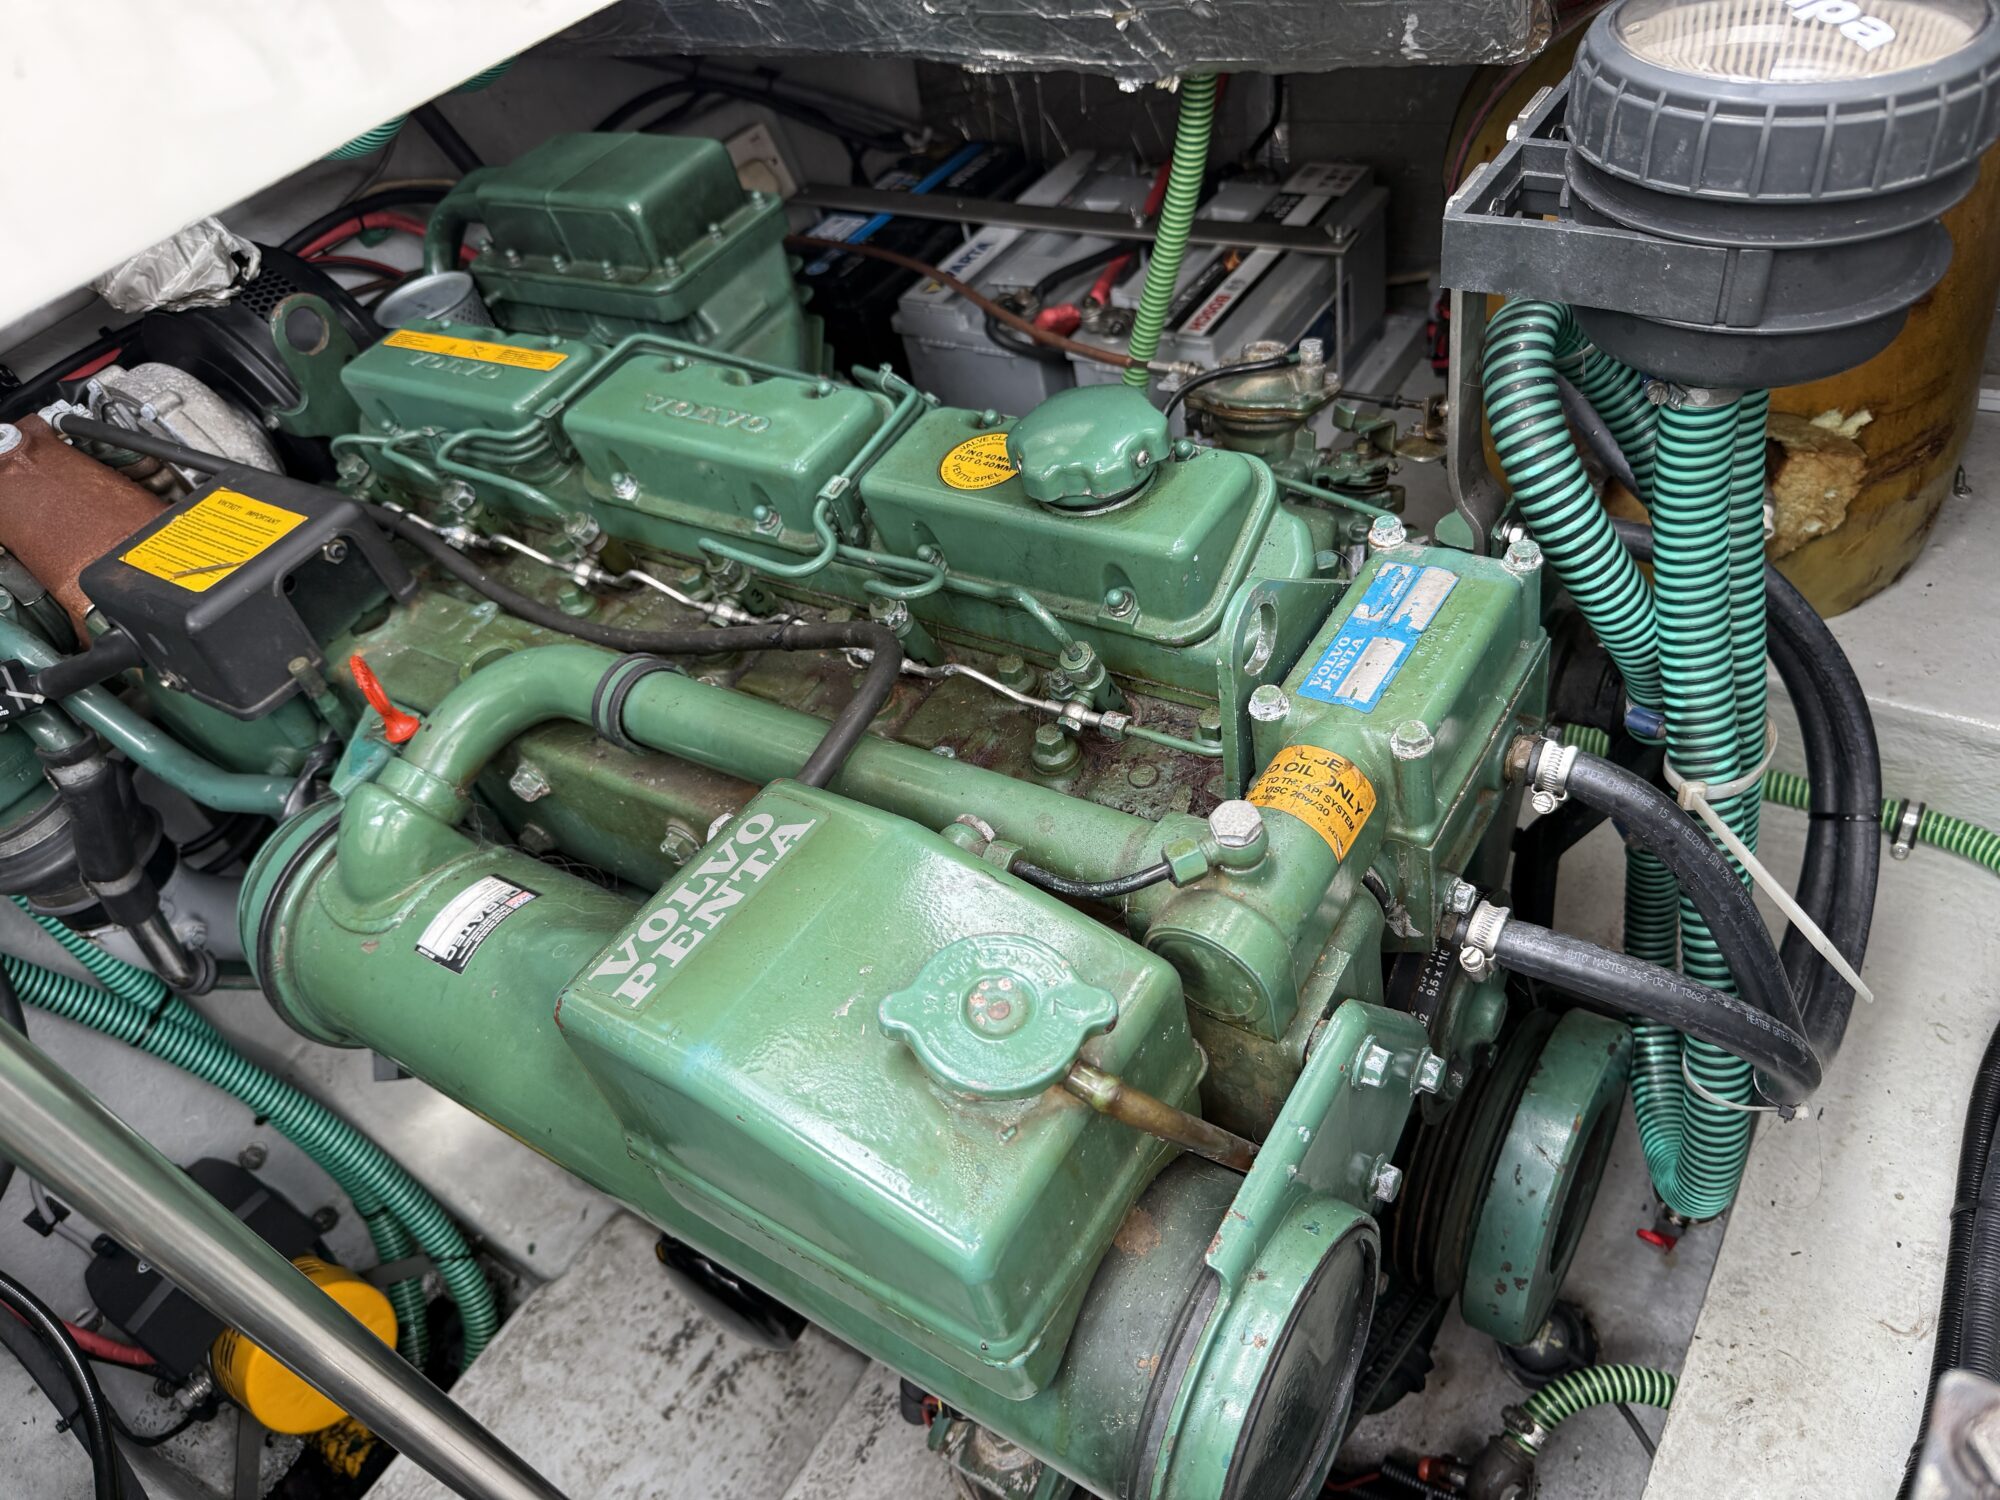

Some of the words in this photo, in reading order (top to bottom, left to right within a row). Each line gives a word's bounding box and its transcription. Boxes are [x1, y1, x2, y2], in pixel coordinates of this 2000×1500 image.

[644, 393, 772, 434] VOLVO
[1307, 636, 1350, 688] VOLVO
[1320, 636, 1367, 692] PENTA
[1265, 786, 1289, 795] VISC
[1283, 762, 1314, 778] OIL
[1303, 783, 1324, 797] API
[1323, 794, 1356, 833] SYSTEM
[1606, 776, 1657, 811] CHAUFFAGE
[1657, 805, 1671, 819] 15
[1681, 825, 1709, 856] HEIZUNG
[1707, 851, 1722, 871] DIN
[587, 812, 775, 982] VOLVO
[611, 818, 817, 1008] PENTA
[1426, 978, 1441, 997] 9,5
[1592, 956, 1628, 975] MASTER
[1745, 1012, 1771, 1033] HEATER
